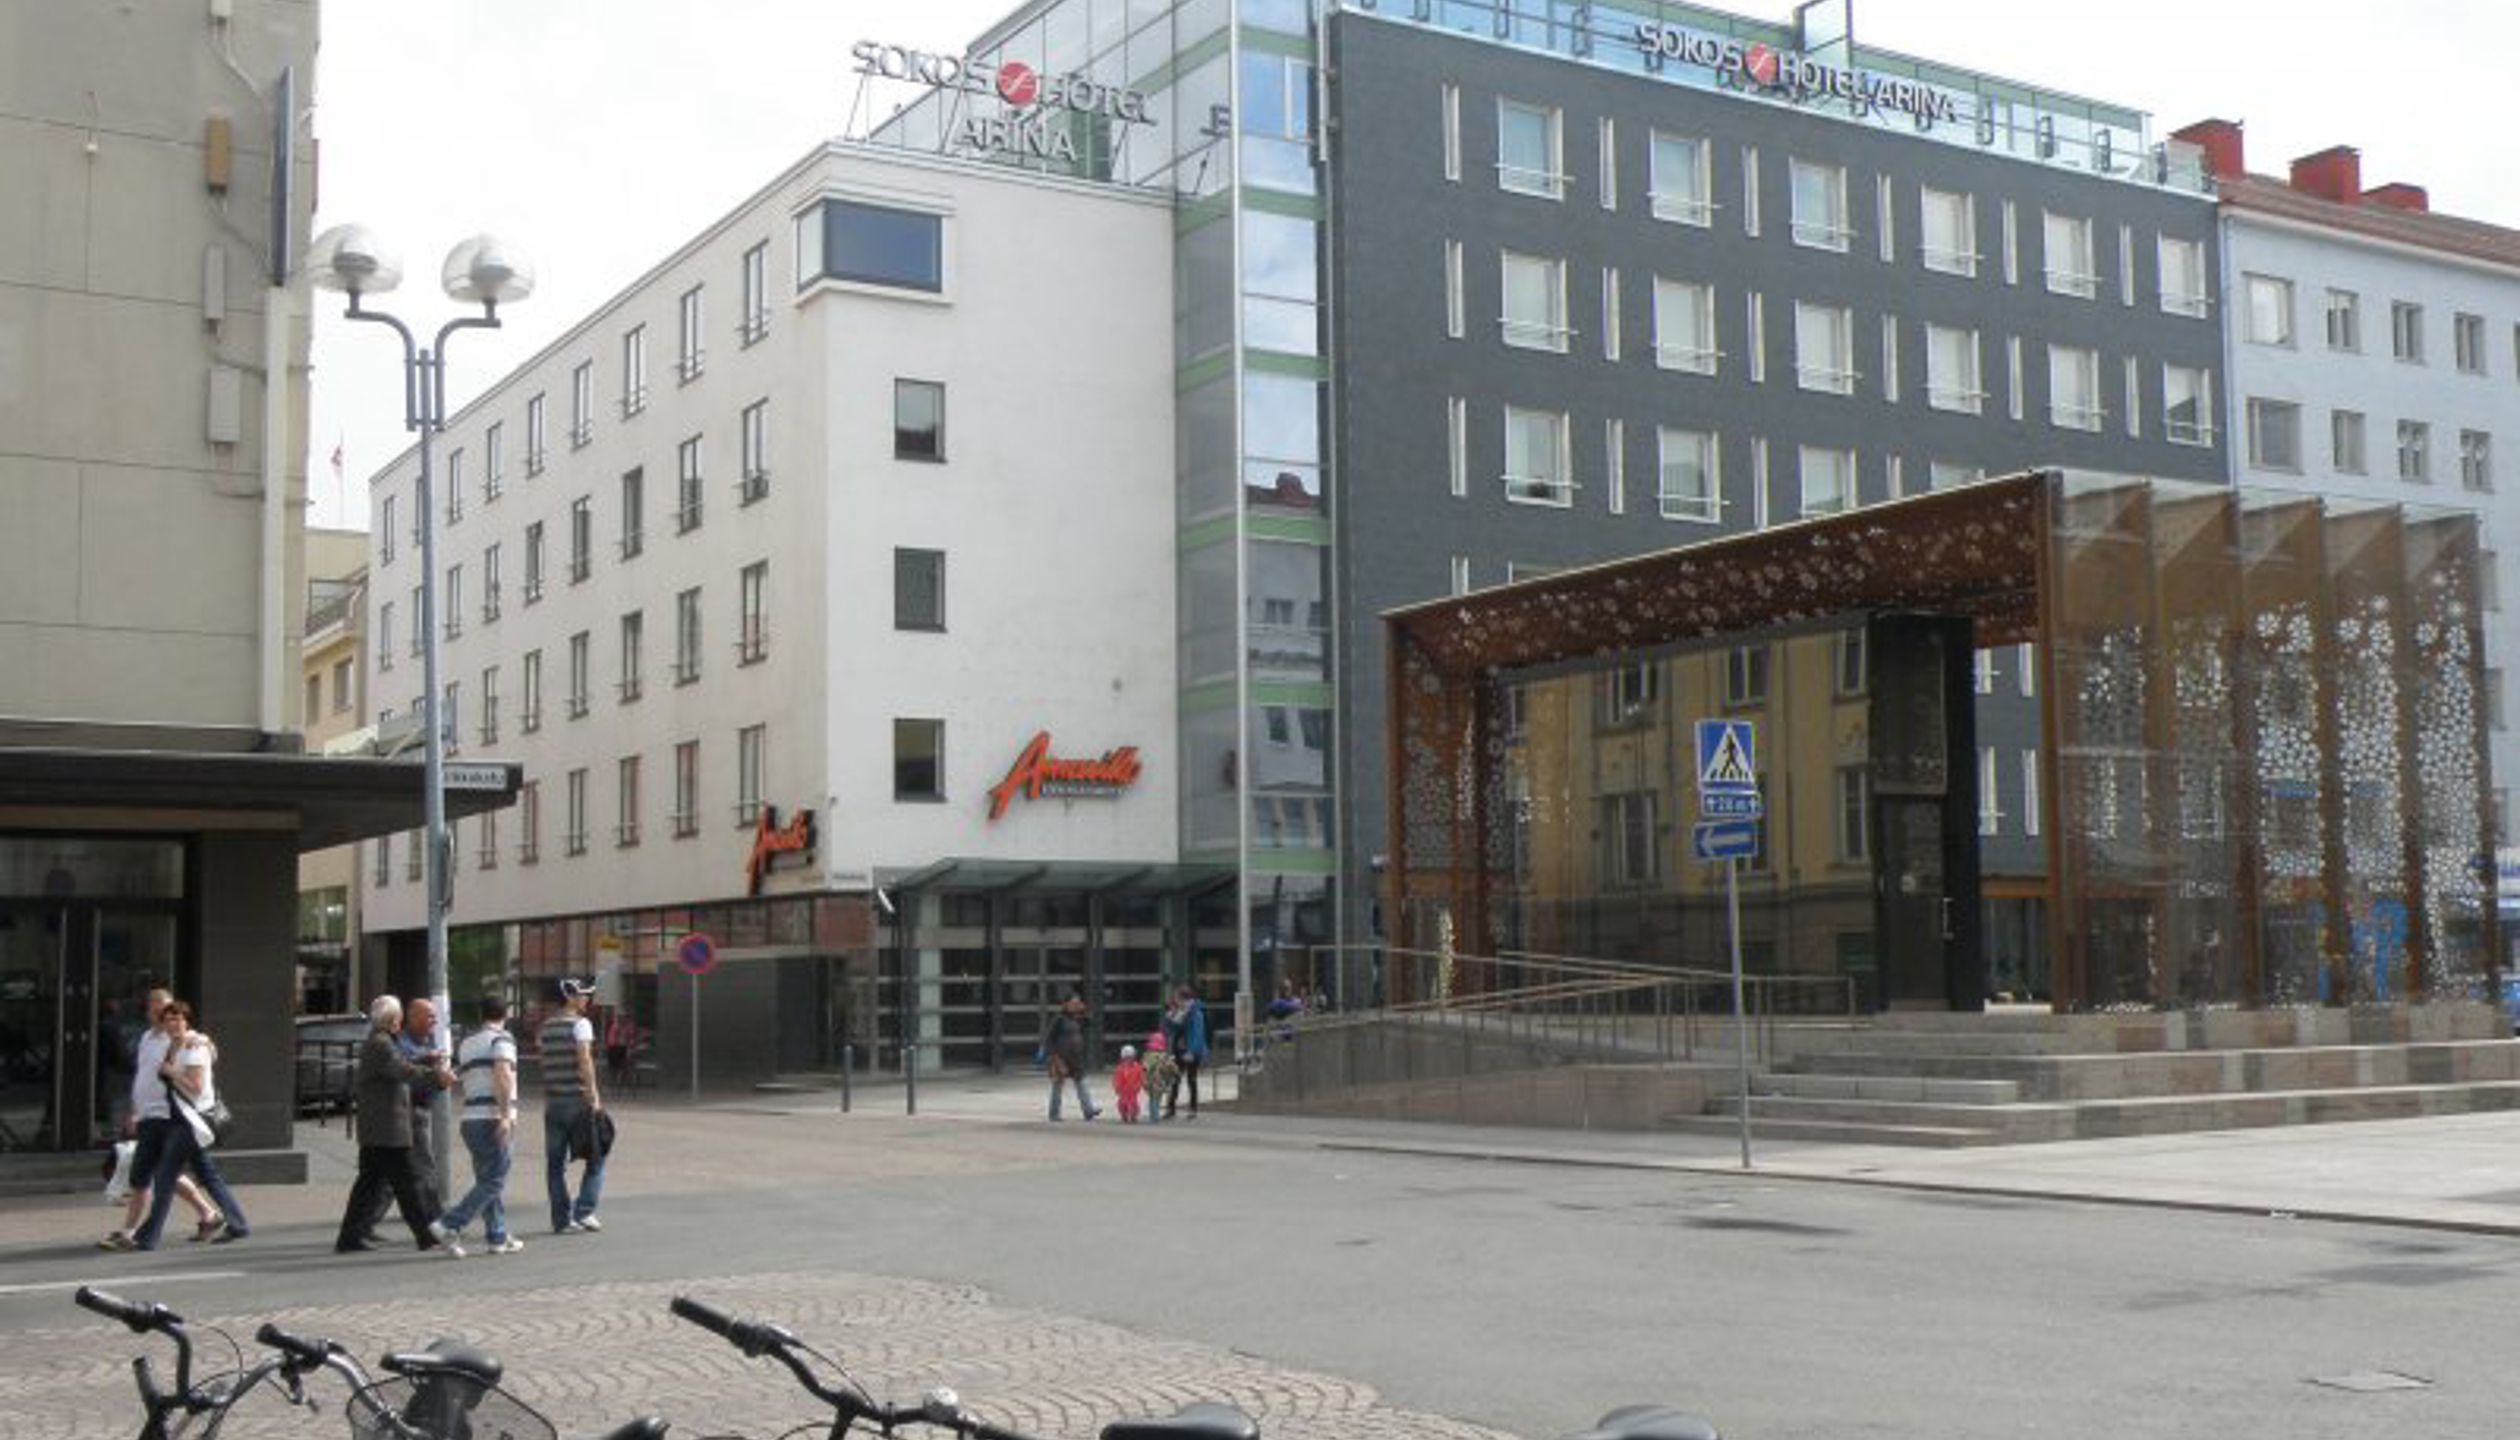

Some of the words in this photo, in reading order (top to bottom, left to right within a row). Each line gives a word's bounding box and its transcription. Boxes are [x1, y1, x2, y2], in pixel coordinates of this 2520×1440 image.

[850, 40, 993, 95] SOKOS
[1037, 72, 1158, 125] HOTEL
[1635, 22, 1744, 71] SOKOS
[1777, 51, 1872, 100] HOTEL
[1874, 77, 1956, 122] ARINA
[954, 113, 1078, 162] ARINA
